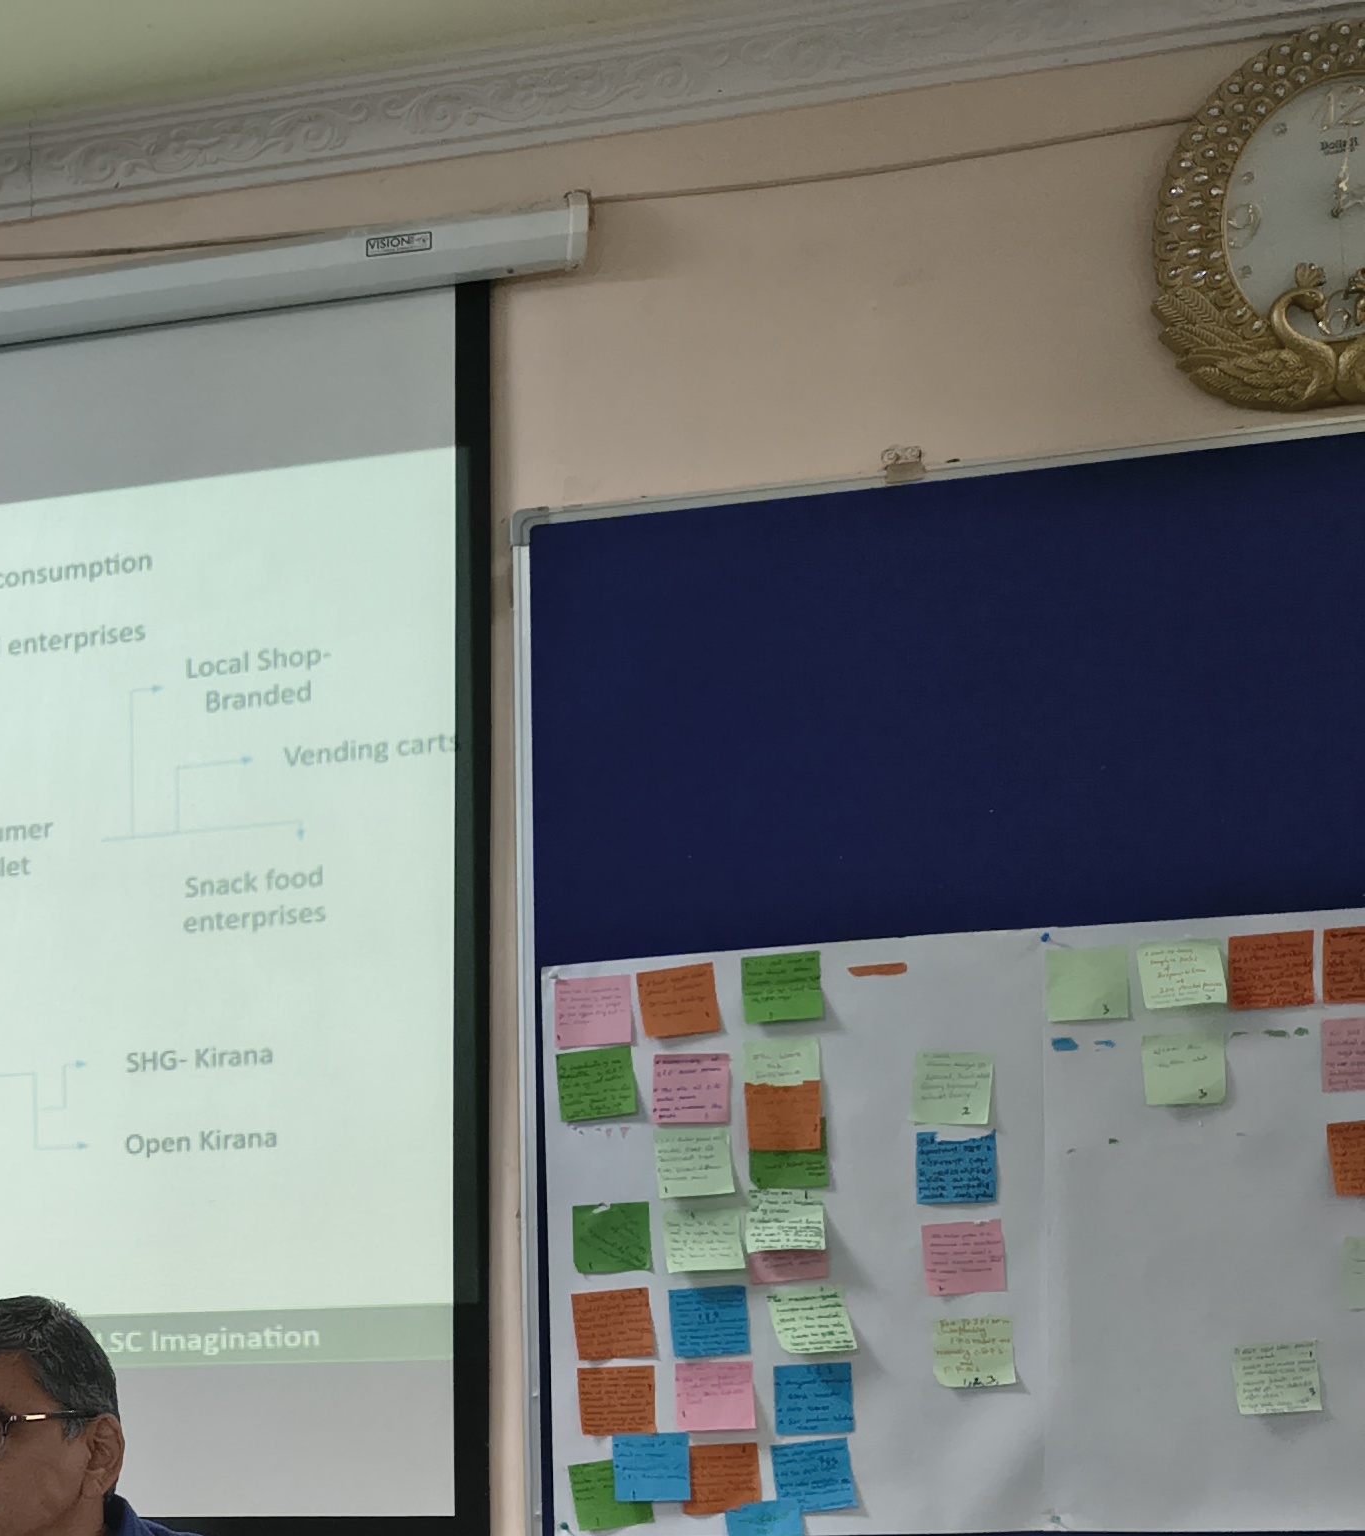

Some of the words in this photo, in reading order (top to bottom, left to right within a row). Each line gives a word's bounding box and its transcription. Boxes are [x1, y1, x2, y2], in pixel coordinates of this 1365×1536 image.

[368, 236, 410, 250] VISION
[7, 620, 147, 659] enterprises
[186, 650, 250, 681] Local
[257, 642, 333, 678] Shop-
[205, 679, 313, 715] Branded
[284, 734, 388, 770] Vending
[396, 729, 459, 756] carts
[184, 870, 258, 900] Snack
[265, 863, 324, 893] food
[183, 902, 327, 937] enterprises
[125, 1047, 188, 1075] SHG-
[194, 1042, 274, 1071] Kirana
[125, 1131, 192, 1161] Open
[199, 1127, 279, 1155] Kirana
[150, 1326, 321, 1359] Imagination
